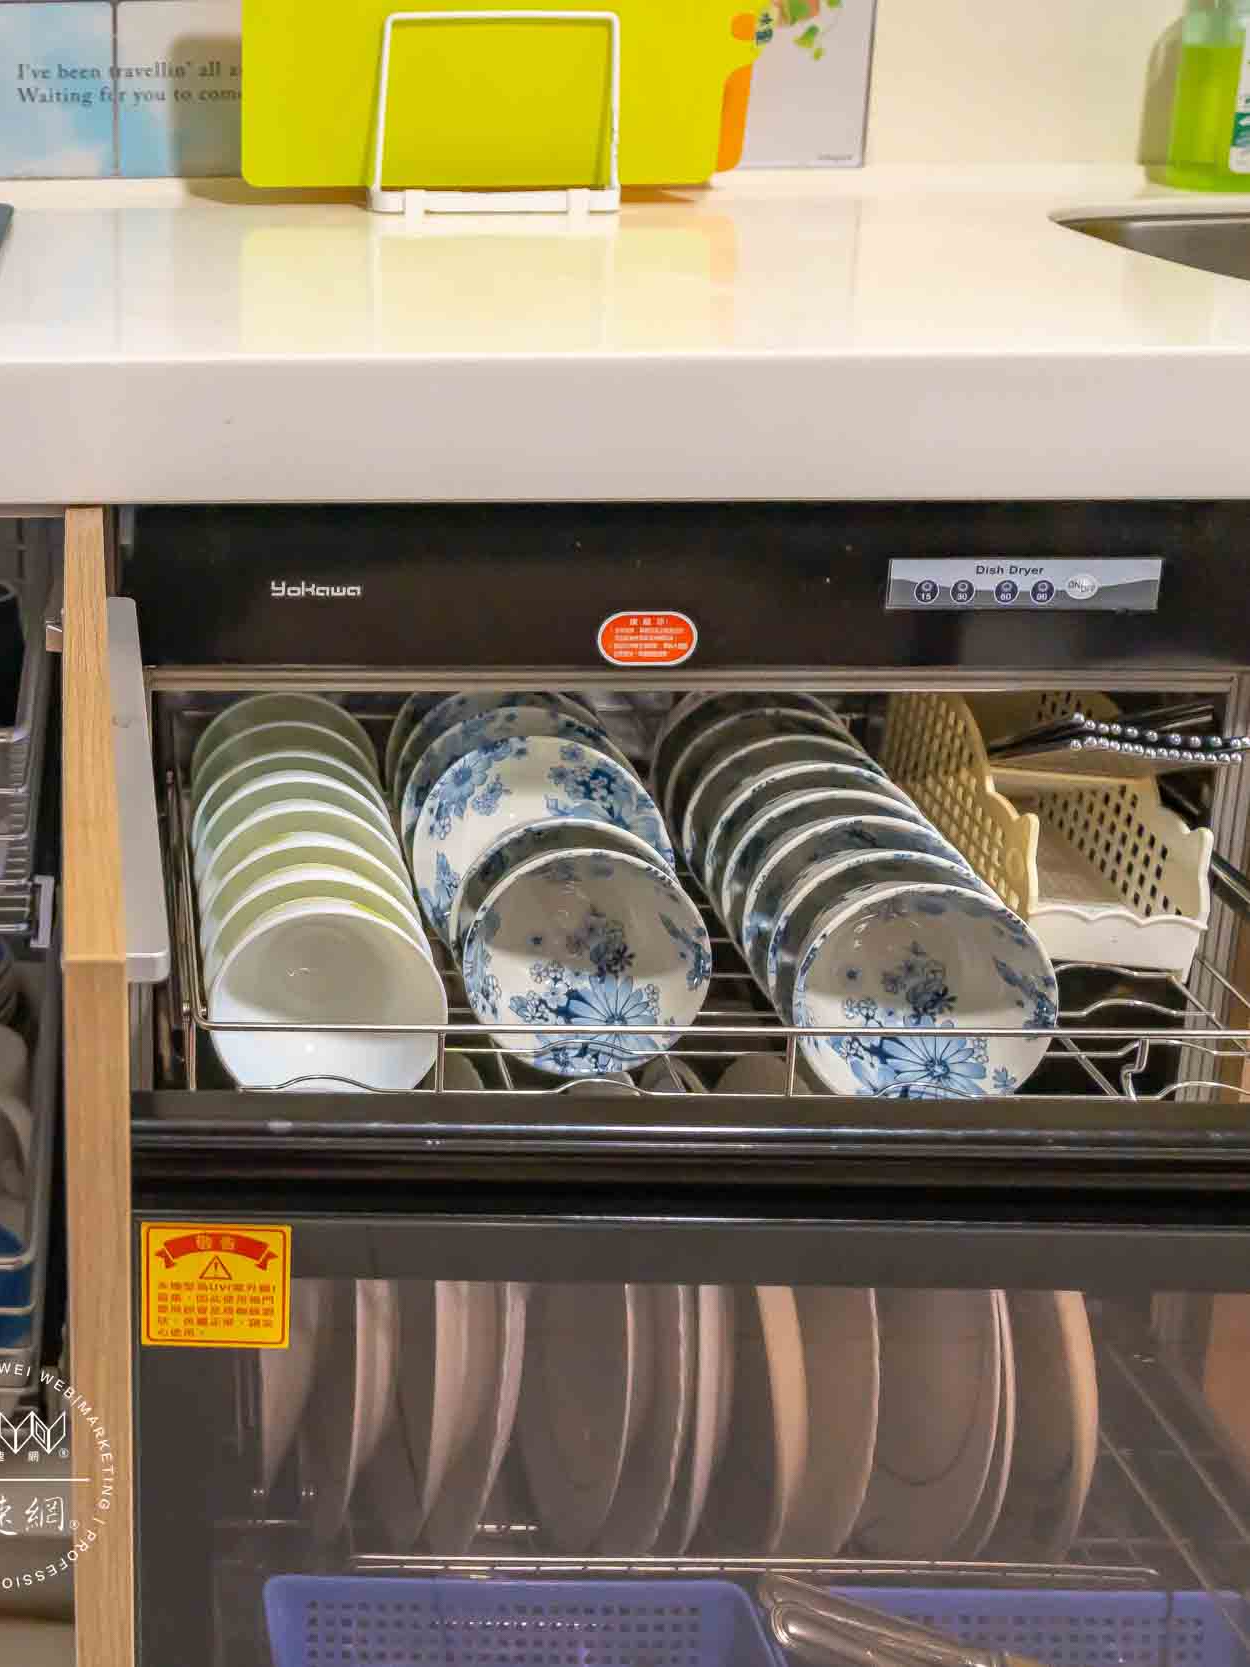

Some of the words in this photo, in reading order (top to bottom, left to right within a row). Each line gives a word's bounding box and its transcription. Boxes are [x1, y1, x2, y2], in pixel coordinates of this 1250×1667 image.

[17, 63, 50, 80] I've
[57, 63, 102, 80] been
[198, 61, 221, 77] all
[17, 87, 93, 107] Waiting
[133, 89, 166, 107] you
[174, 88, 192, 102] to
[976, 565, 1004, 575] Dish
[1010, 565, 1044, 577] Dryer
[921, 592, 932, 601] 15
